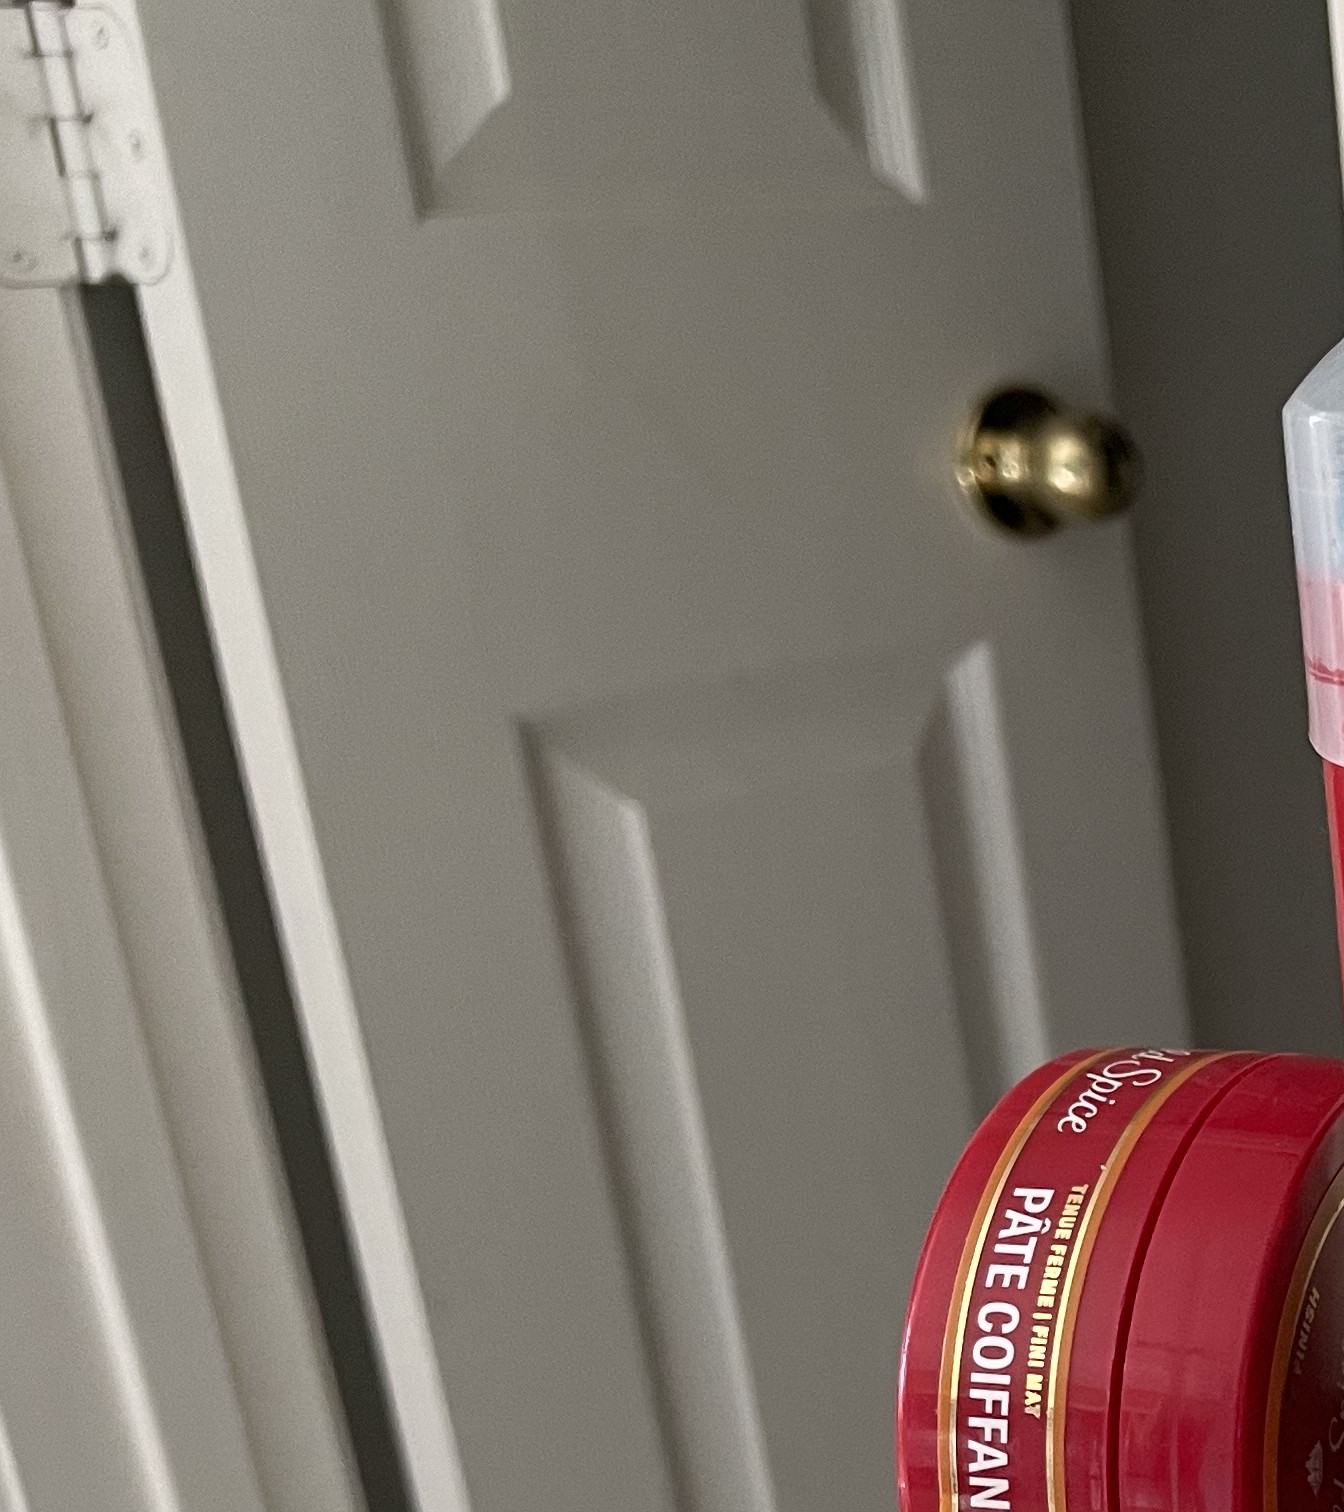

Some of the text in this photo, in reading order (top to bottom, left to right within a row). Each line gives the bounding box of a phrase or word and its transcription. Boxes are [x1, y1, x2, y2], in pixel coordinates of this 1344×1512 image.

[1057, 1060, 1161, 1133] Spice
[985, 1187, 1056, 1290] PÂTE
[1027, 1325, 1051, 1367] FINI
[1024, 1374, 1044, 1419] MAT
